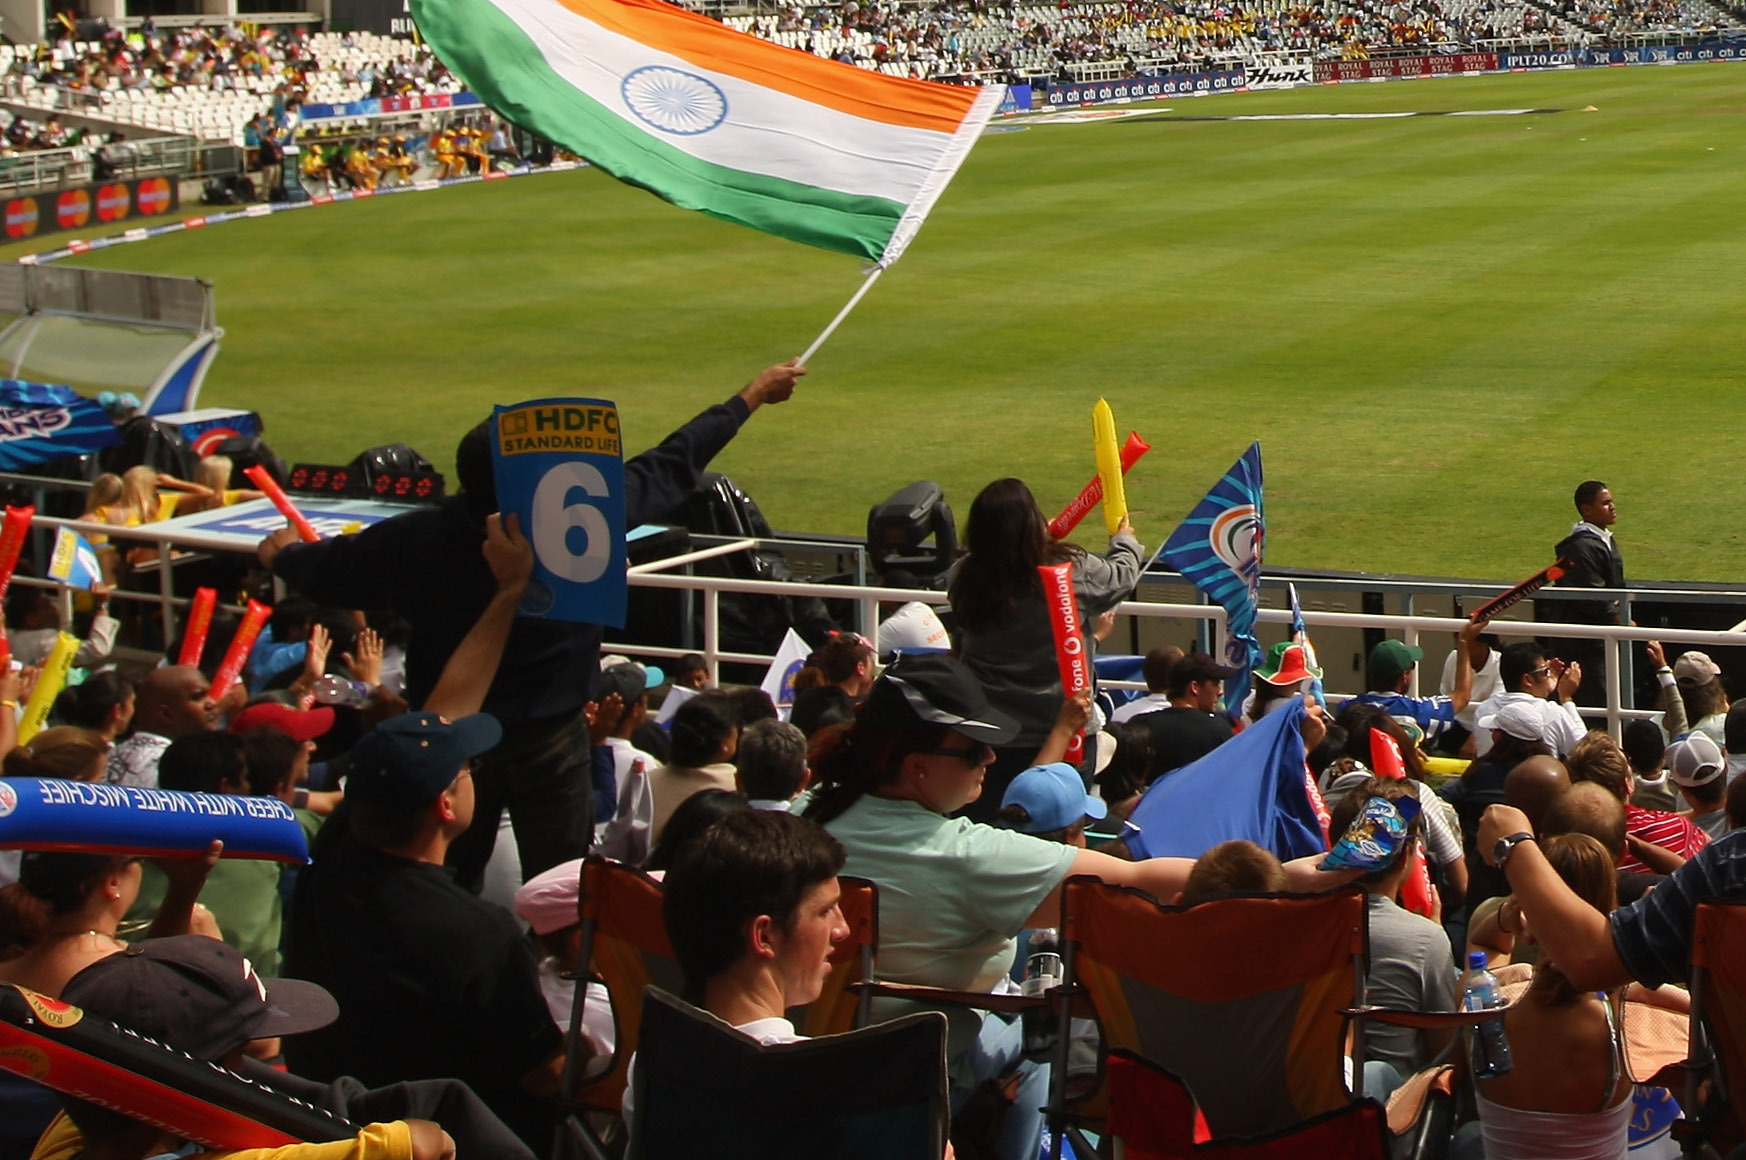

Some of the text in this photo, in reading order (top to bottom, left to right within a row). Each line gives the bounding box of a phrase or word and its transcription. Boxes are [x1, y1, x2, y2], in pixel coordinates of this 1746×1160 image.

[1314, 64, 1333, 72] OYAL
[1338, 63, 1363, 71] ROYAL
[1369, 61, 1394, 69] ROYAL
[1398, 59, 1424, 67] ROYAL
[1429, 57, 1455, 65] ROYAL
[1462, 55, 1488, 63] ROYAL
[1507, 53, 1568, 67] IPLT20.CO
[1246, 67, 1311, 85] Hunk
[1316, 72, 1332, 80] TAG
[1340, 71, 1361, 79] STAG
[1372, 69, 1392, 77] STAG
[1401, 66, 1422, 74] STAG
[1431, 64, 1453, 73] STAG
[1464, 62, 1485, 70] STAG
[535, 408, 617, 433] HDFC
[504, 436, 619, 454] STANDARD LIFE
[532, 461, 611, 584] 6
[1054, 567, 1076, 634] vodafone
[39, 779, 295, 821] CHEER WITH WHITE MISCHIEF
